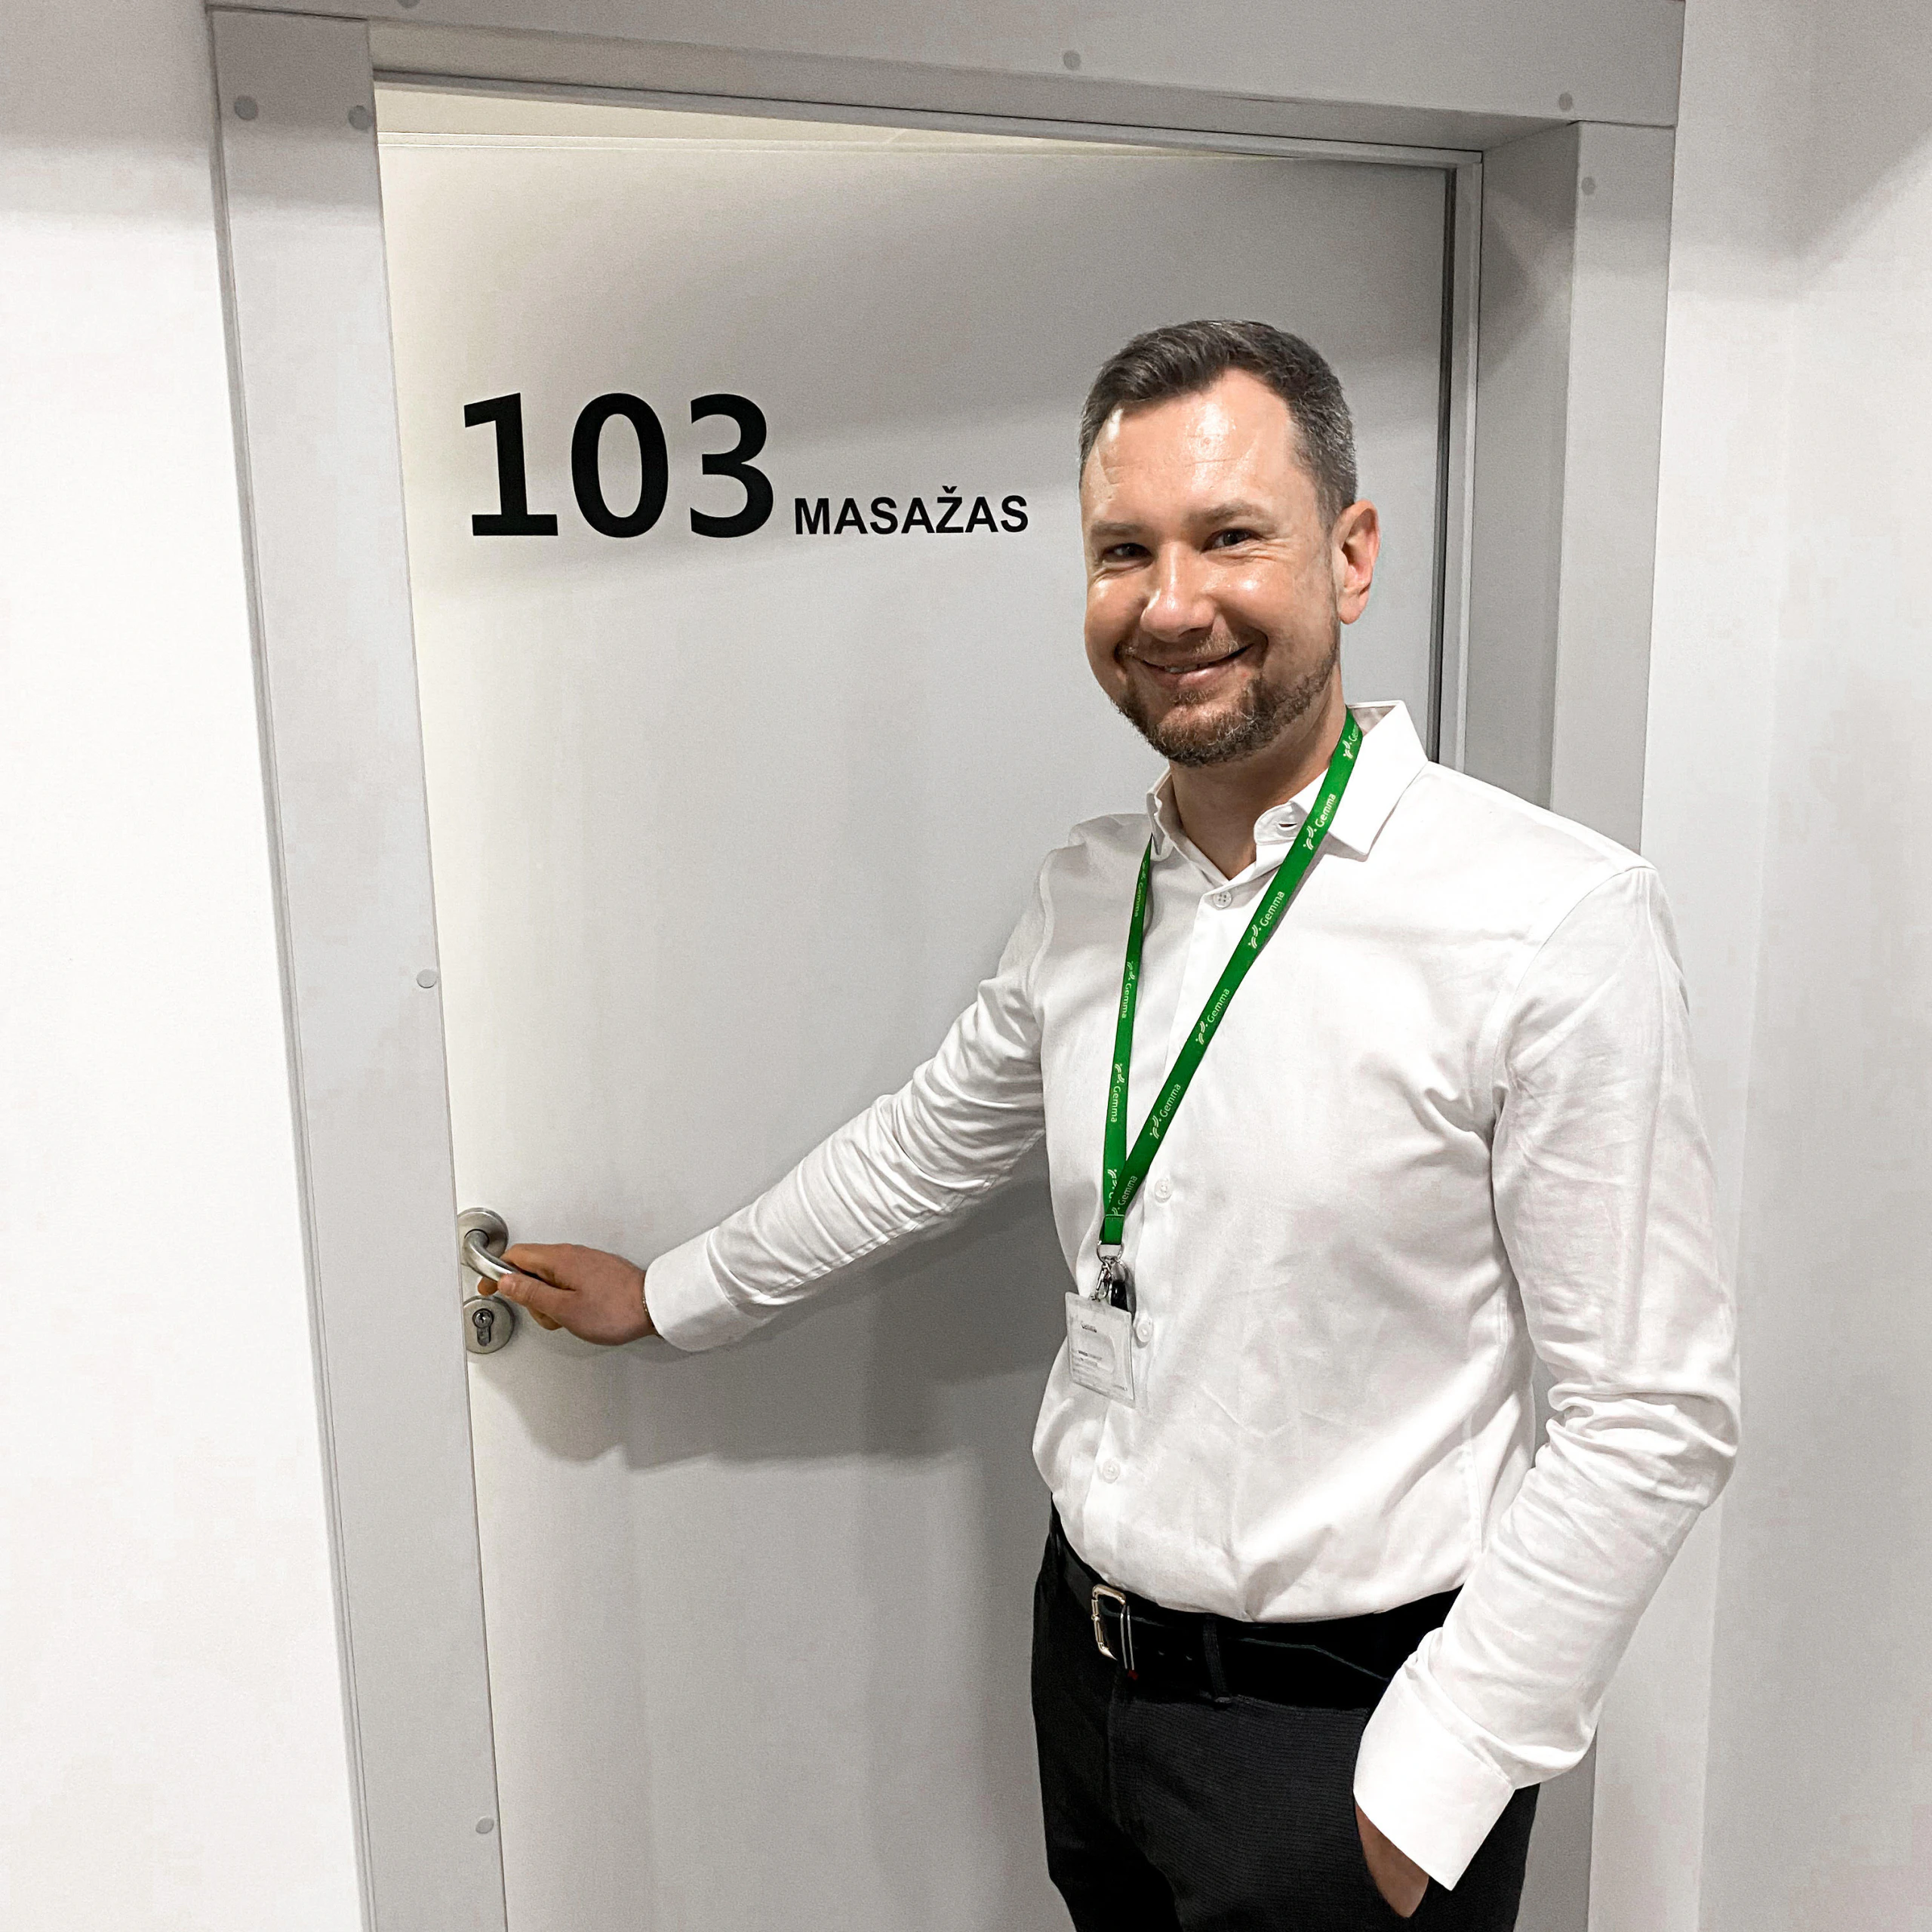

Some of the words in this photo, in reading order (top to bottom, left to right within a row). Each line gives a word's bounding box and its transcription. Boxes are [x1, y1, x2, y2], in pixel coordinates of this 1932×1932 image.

[464, 392, 774, 538] 103
[794, 486, 1029, 534] MASAŽAS
[1315, 793, 1337, 828] Gemma
[1134, 881, 1143, 918] Gemma
[1260, 891, 1284, 927] Gemma
[1121, 983, 1132, 1019] Gemma
[1207, 988, 1230, 1023] Gemma
[1111, 1085, 1121, 1123] Gemma
[1159, 1083, 1181, 1118] Gemma
[1118, 1175, 1138, 1205] Gemma
